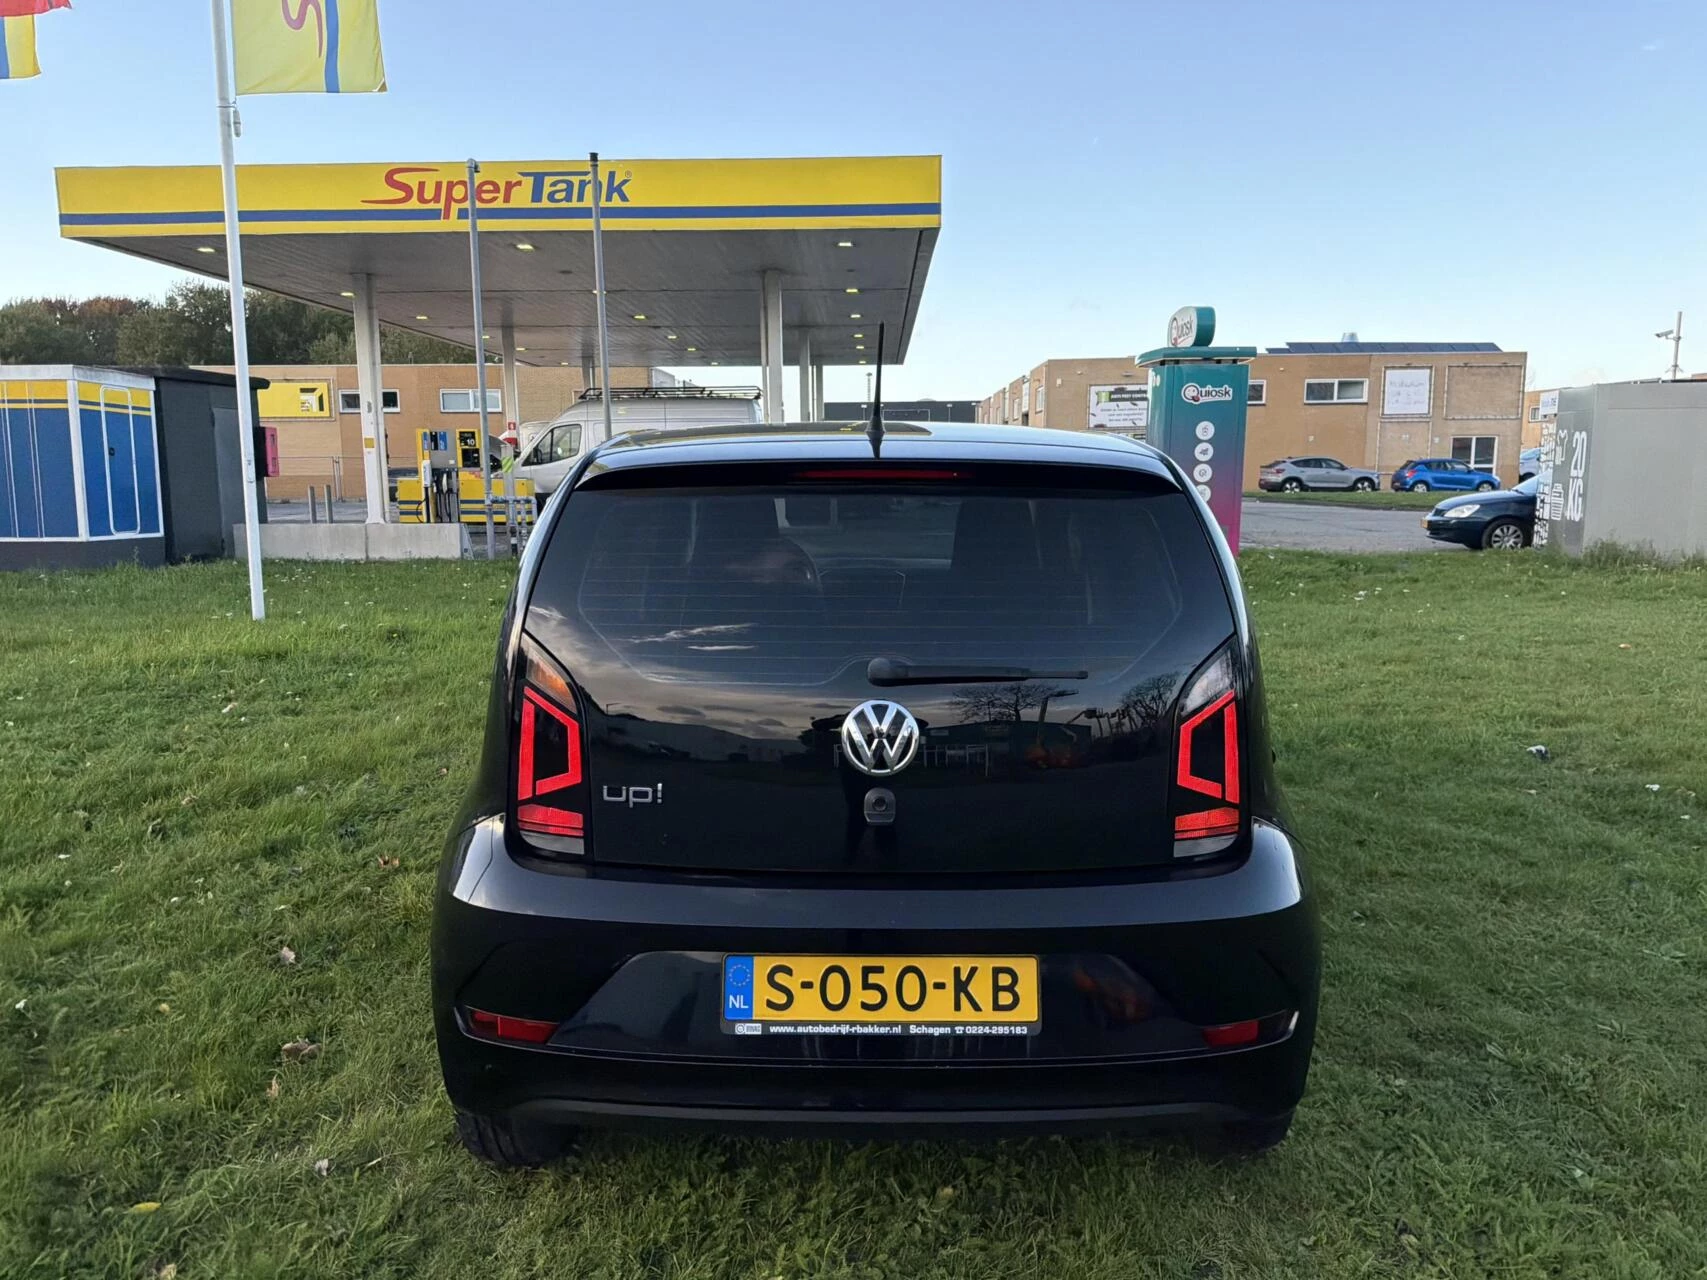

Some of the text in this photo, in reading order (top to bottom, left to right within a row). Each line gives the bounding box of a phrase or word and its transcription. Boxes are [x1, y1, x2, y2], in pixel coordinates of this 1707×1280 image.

[1183, 384, 1231, 402] Quiosk
[1570, 430, 1588, 477] 20
[602, 783, 663, 808] up!
[765, 964, 1021, 1012] S-050-KB
[729, 994, 749, 1009] NL
[769, 1024, 902, 1036] www.autobedrijf-rbakker.nl
[909, 1024, 951, 1036] Schagen
